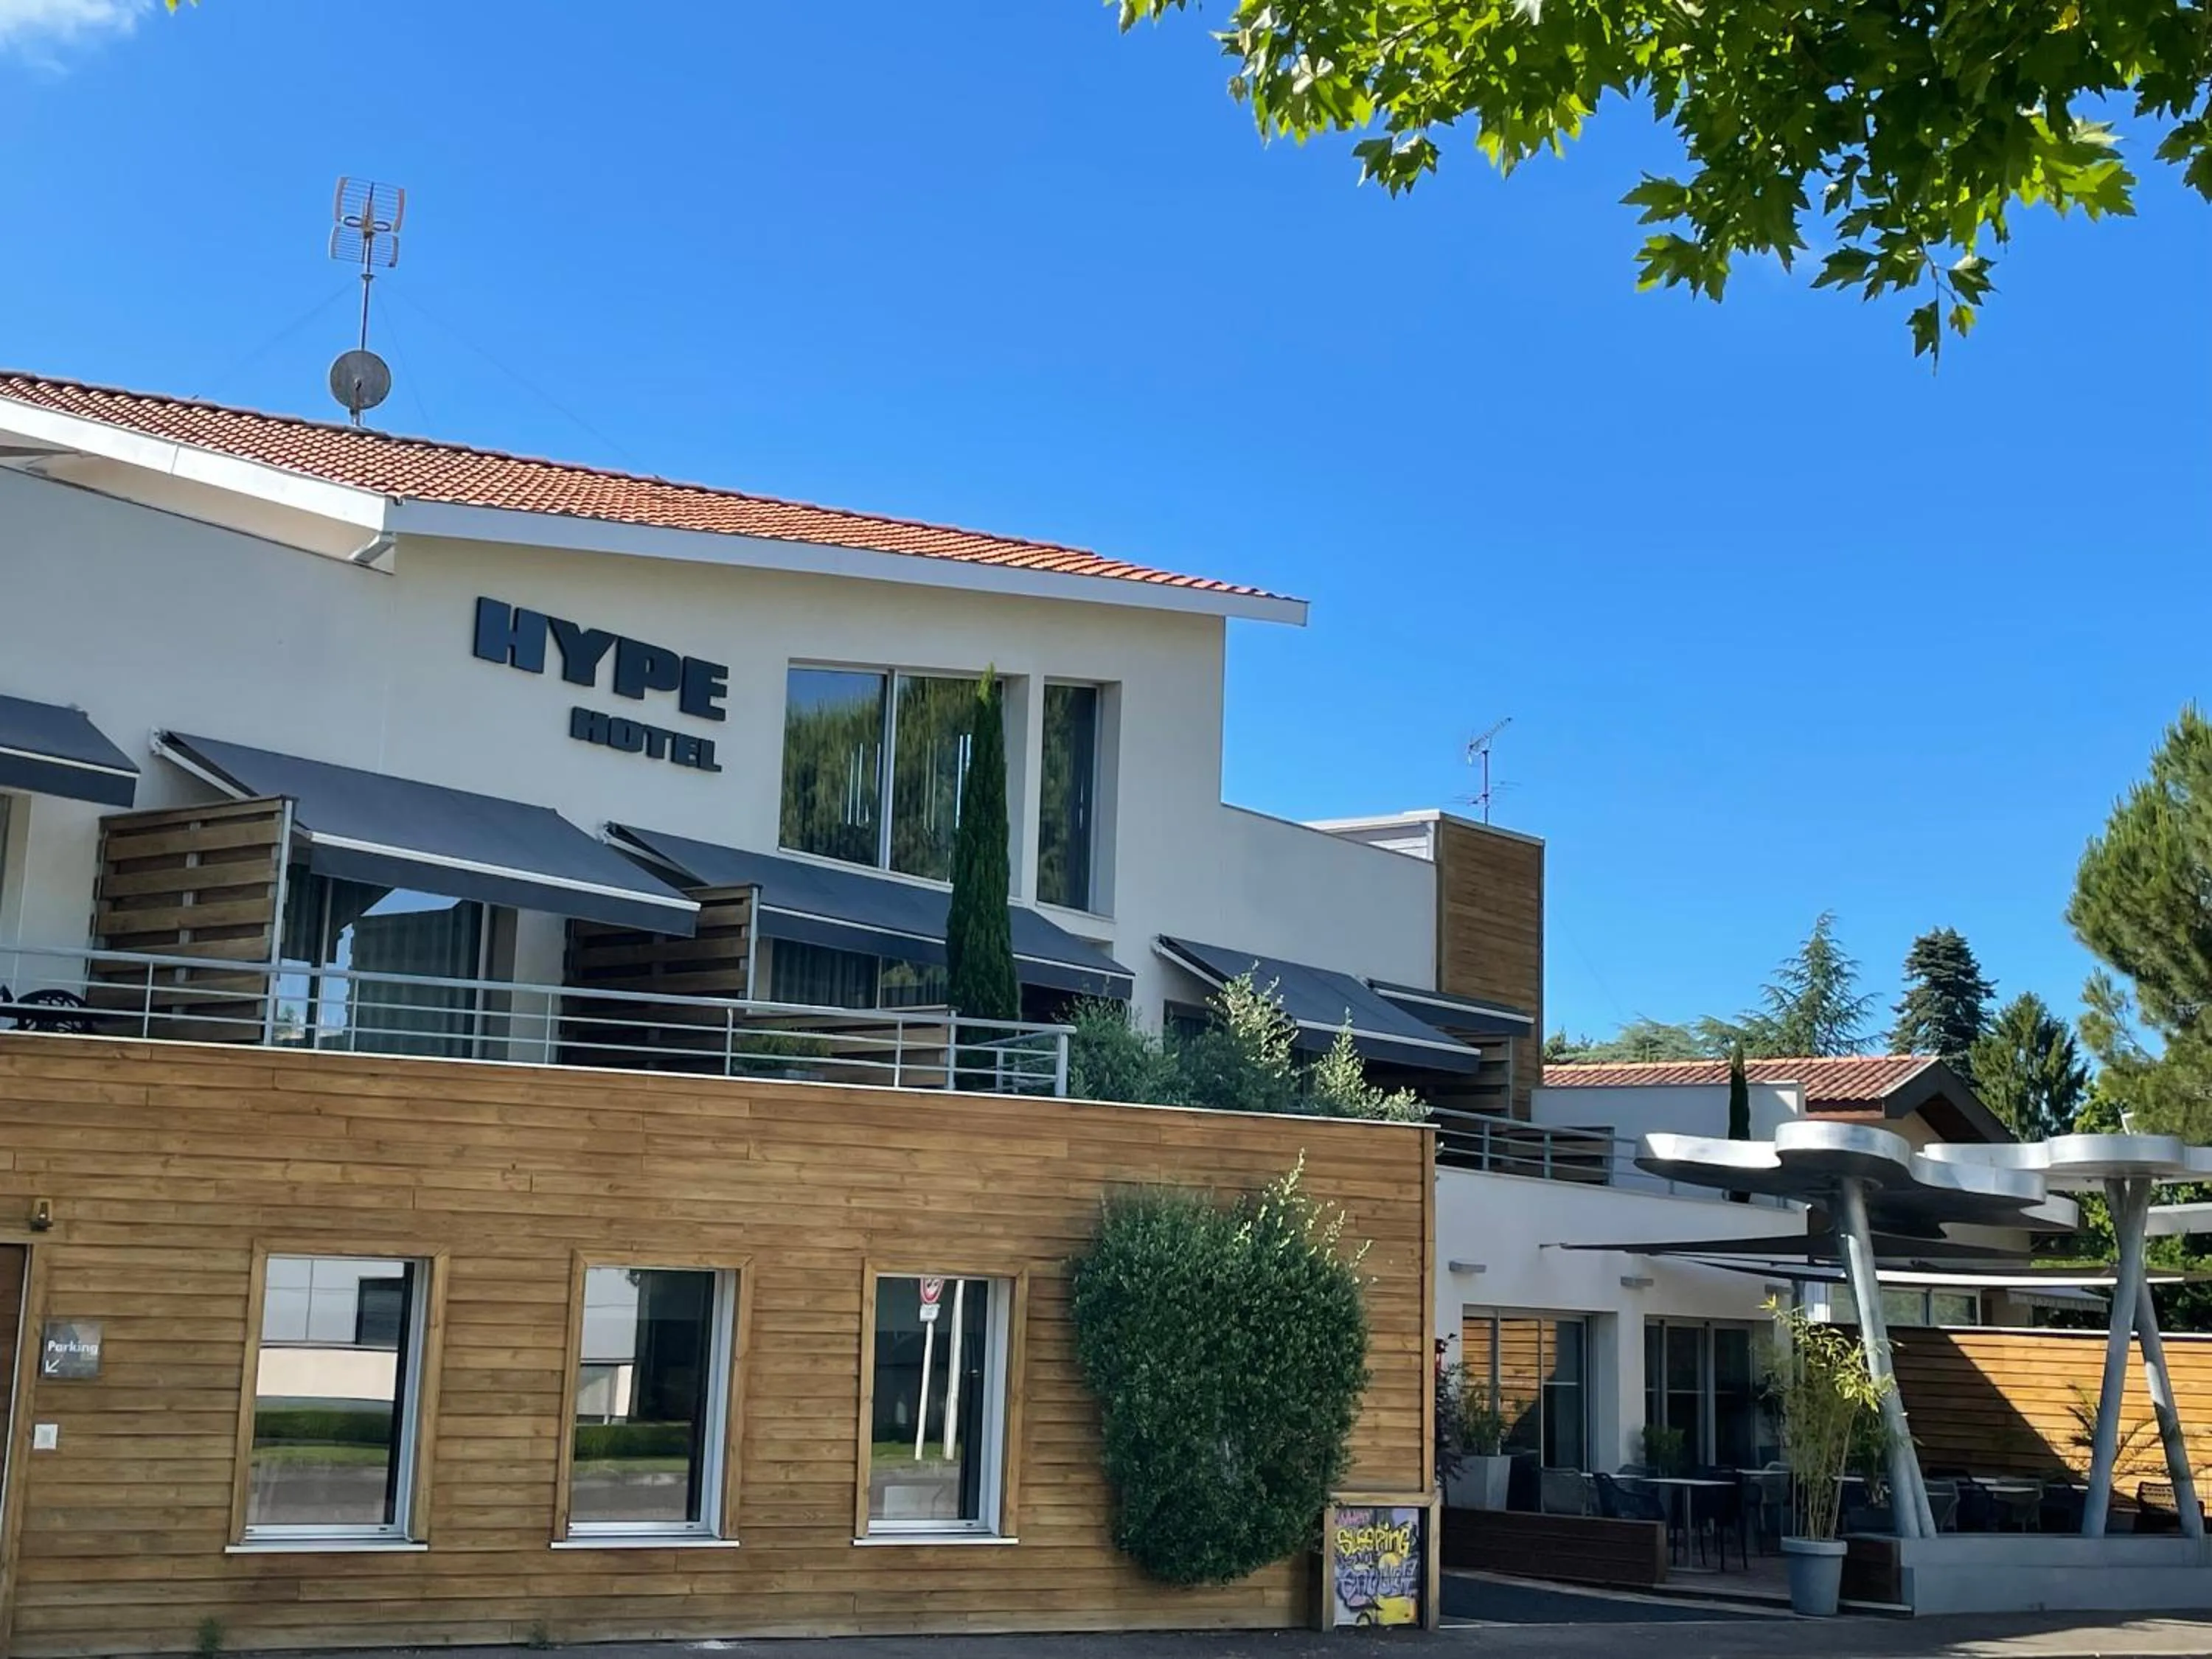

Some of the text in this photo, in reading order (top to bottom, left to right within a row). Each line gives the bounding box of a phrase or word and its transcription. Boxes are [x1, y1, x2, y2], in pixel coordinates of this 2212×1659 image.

[473, 597, 728, 722] HYPE
[569, 706, 722, 772] HOTEL
[48, 1340, 99, 1356] Parking
